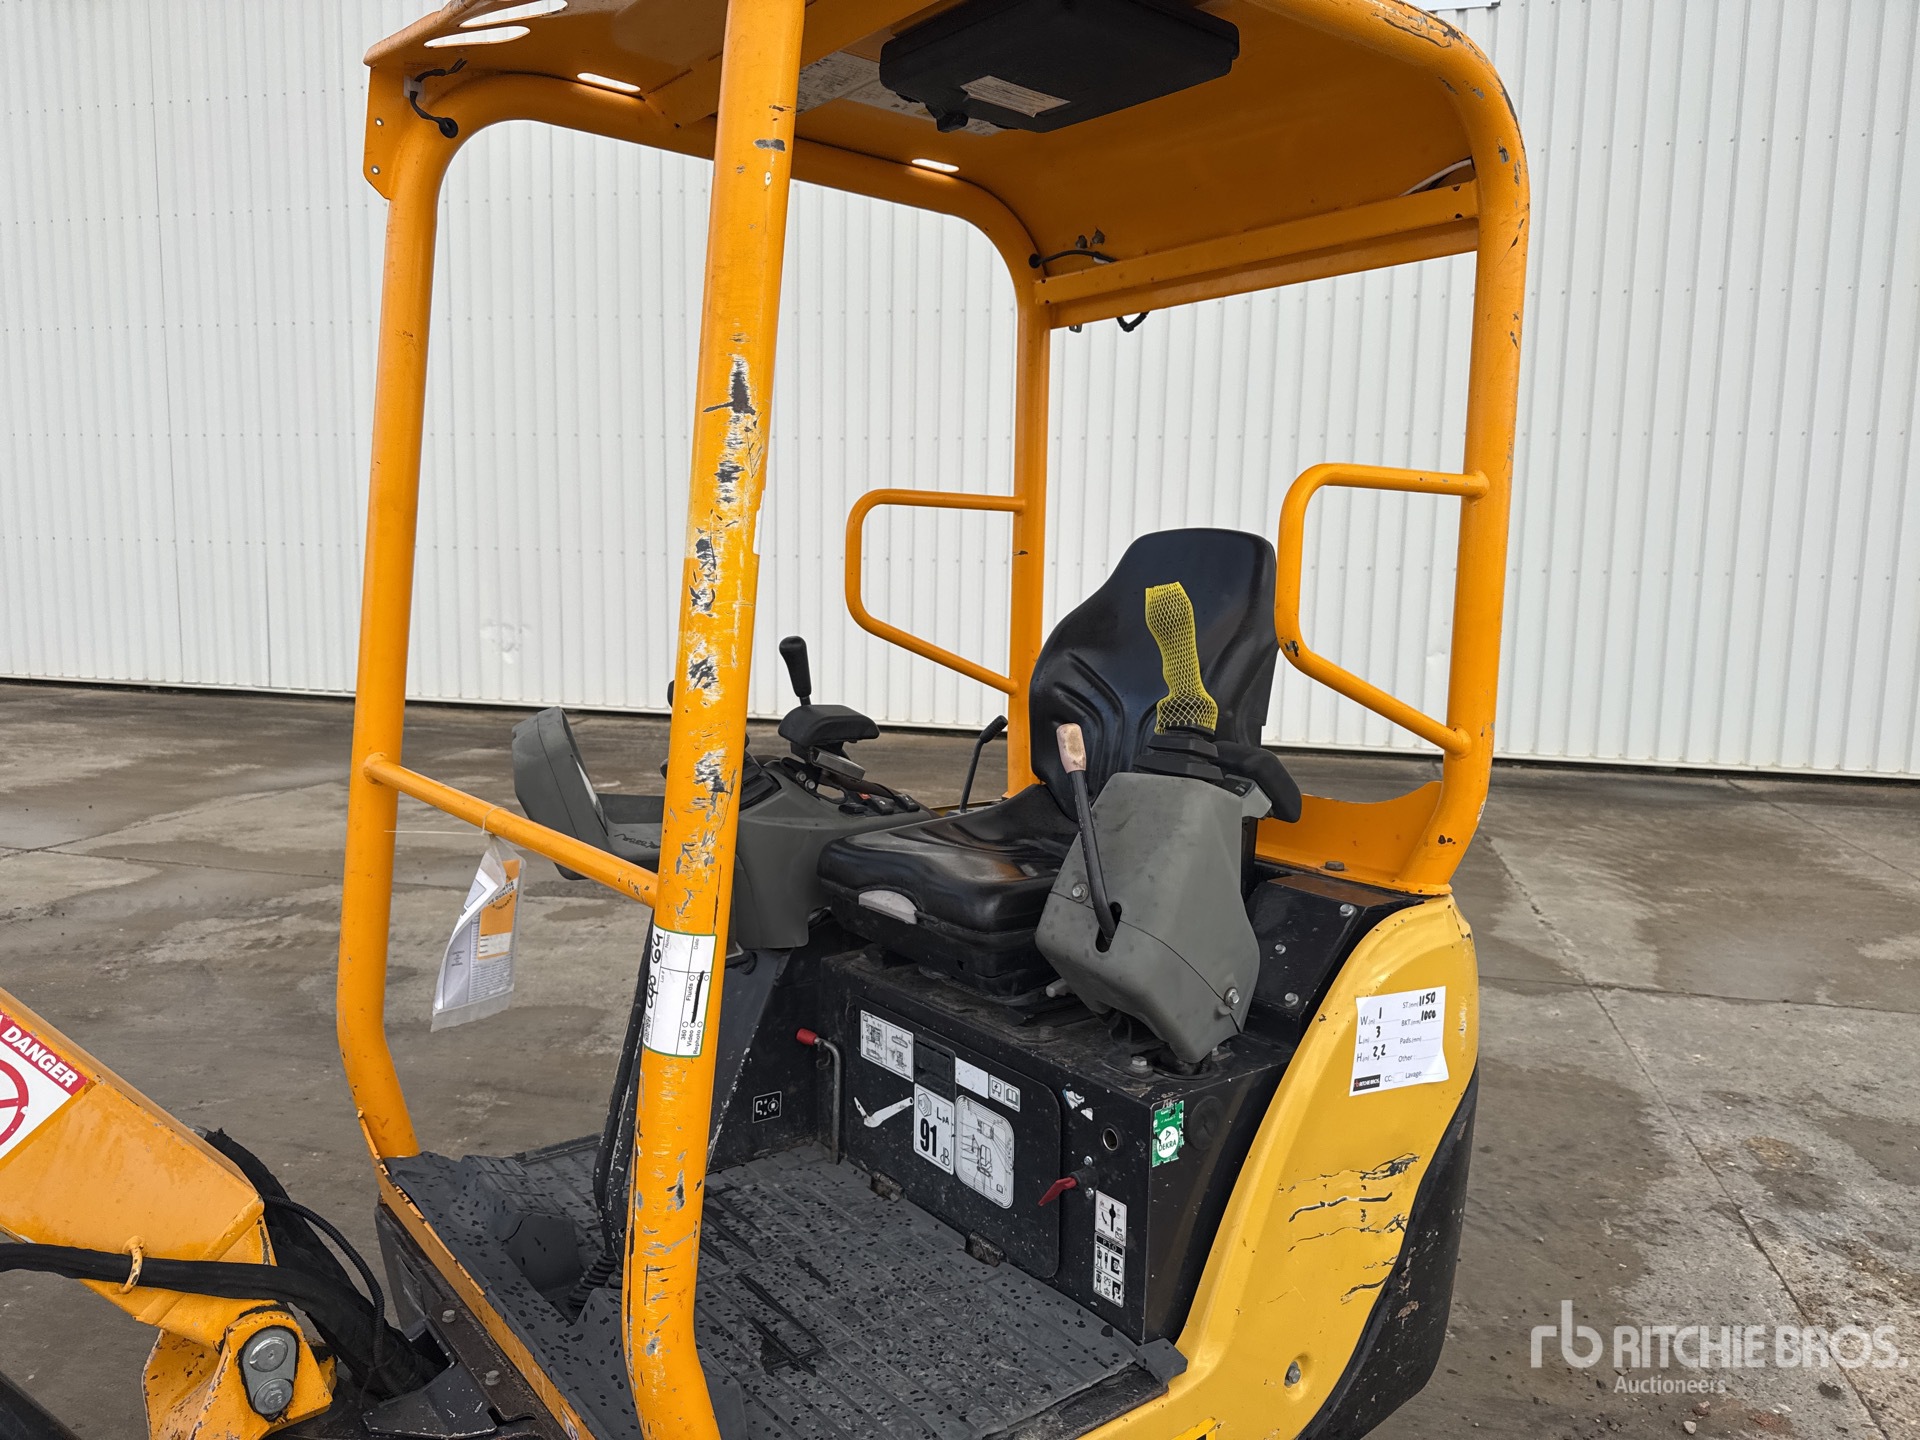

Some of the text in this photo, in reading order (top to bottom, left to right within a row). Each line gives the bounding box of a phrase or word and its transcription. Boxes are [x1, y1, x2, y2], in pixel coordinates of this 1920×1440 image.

[1419, 992, 1436, 1006] 1150
[1378, 1006, 1382, 1019] 1
[1376, 1025, 1381, 1038] 3
[693, 1029, 701, 1055] Rephoto
[1, 1025, 78, 1088] DANGER
[920, 1117, 937, 1158] 91
[1158, 1140, 1177, 1152] DEKRA
